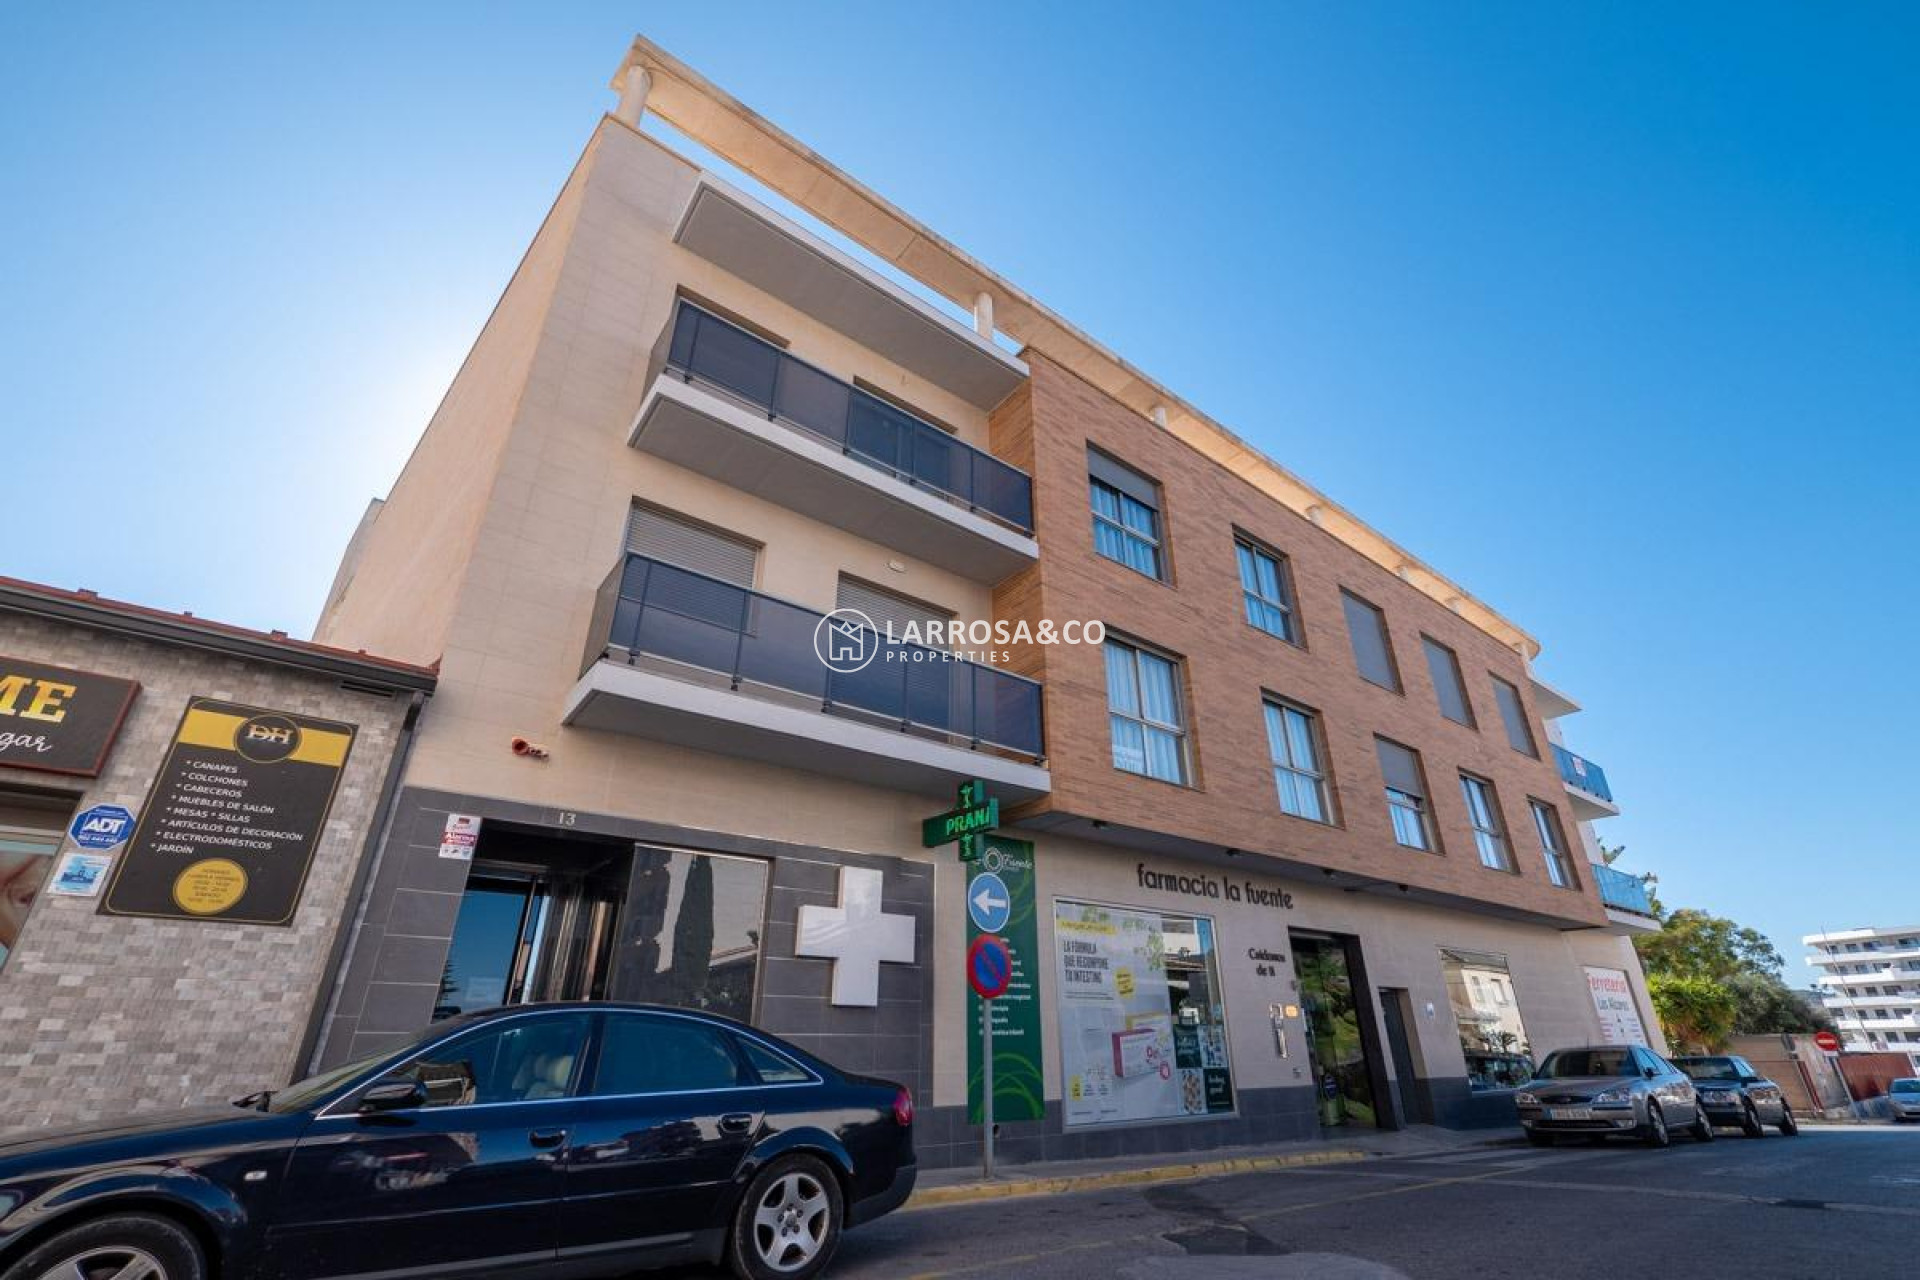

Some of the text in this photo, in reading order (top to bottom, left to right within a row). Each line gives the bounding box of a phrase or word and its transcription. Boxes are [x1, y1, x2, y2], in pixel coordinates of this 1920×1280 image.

[188, 772, 248, 787] COLCHONES
[183, 783, 242, 798] CABECEROS
[178, 795, 225, 809] MUEBLES
[226, 801, 241, 810] DE
[173, 807, 250, 823] MESAS SILLAS
[559, 812, 577, 826] 13
[82, 817, 126, 833] ADT
[225, 826, 240, 834] DE
[1137, 863, 1294, 909] farmacia la fuente
